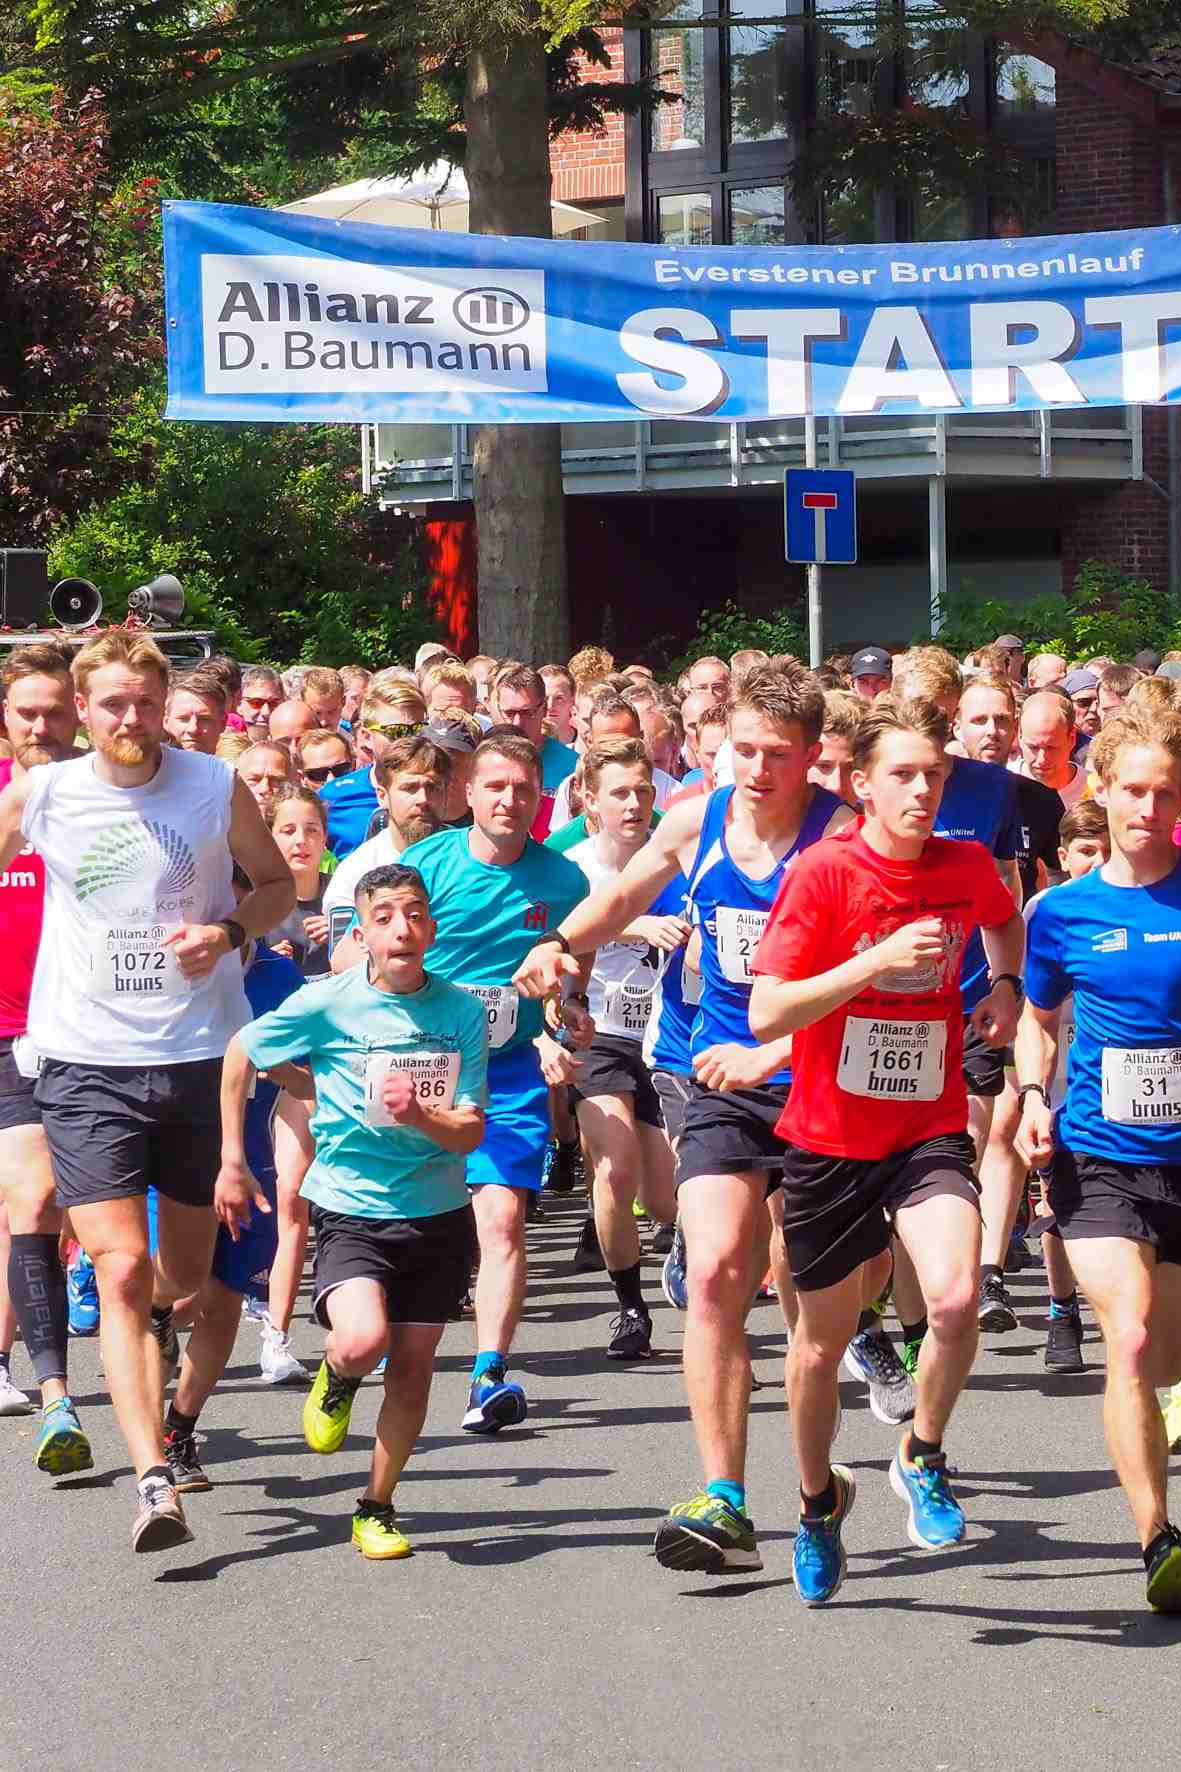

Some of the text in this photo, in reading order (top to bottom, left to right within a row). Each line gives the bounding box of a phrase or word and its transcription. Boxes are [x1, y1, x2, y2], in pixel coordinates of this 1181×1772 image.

[654, 247, 1145, 286] Everstener Brunnenlauf
[217, 281, 435, 324] Allianz
[218, 331, 532, 371] D. Baumann
[737, 913, 768, 926] Allian
[107, 927, 148, 939] Allianz
[120, 940, 160, 951] Bauma
[111, 951, 166, 971] 1072
[115, 973, 163, 991] bruns
[622, 1002, 653, 1016] 218
[624, 1016, 648, 1028] bru
[869, 1022, 913, 1036] Allianz
[881, 1036, 929, 1049] Baumann
[390, 1057, 432, 1069] Allianz
[869, 1049, 923, 1071] 1661
[1123, 1052, 1168, 1064] Allianz
[420, 1080, 446, 1098] 86
[867, 1071, 920, 1093] bruns
[1142, 1077, 1167, 1097] 31
[1132, 1099, 1181, 1118] bruns
